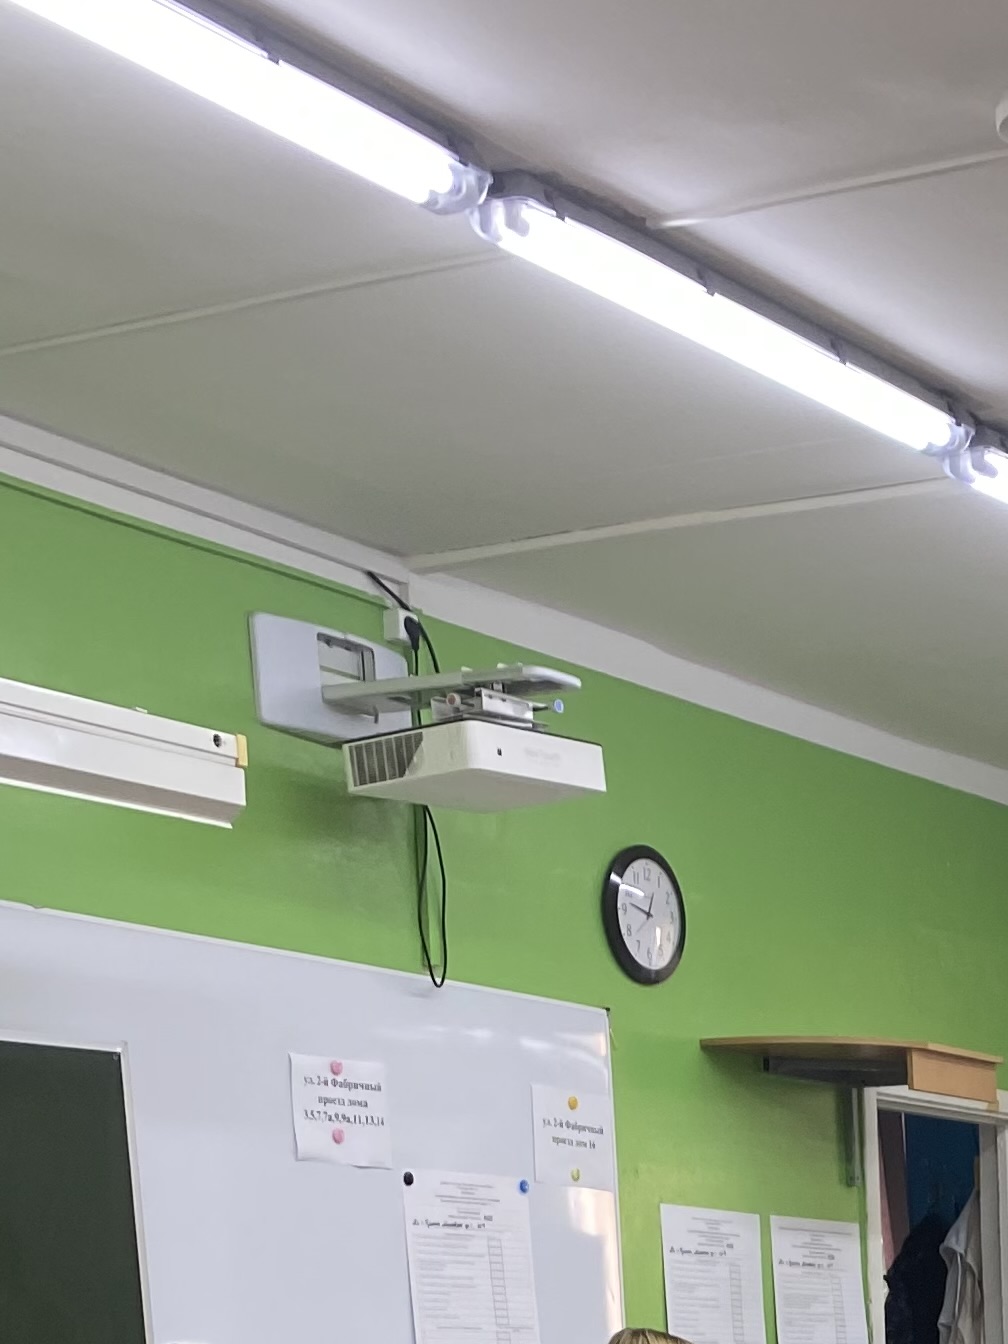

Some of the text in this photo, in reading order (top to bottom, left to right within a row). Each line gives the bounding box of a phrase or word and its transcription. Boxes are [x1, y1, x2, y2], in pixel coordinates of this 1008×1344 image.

[632, 870, 640, 885] 11
[643, 866, 652, 881] 12
[621, 903, 628, 915] 9
[626, 924, 632, 936] 8
[331, 1078, 382, 1092] Фабричный
